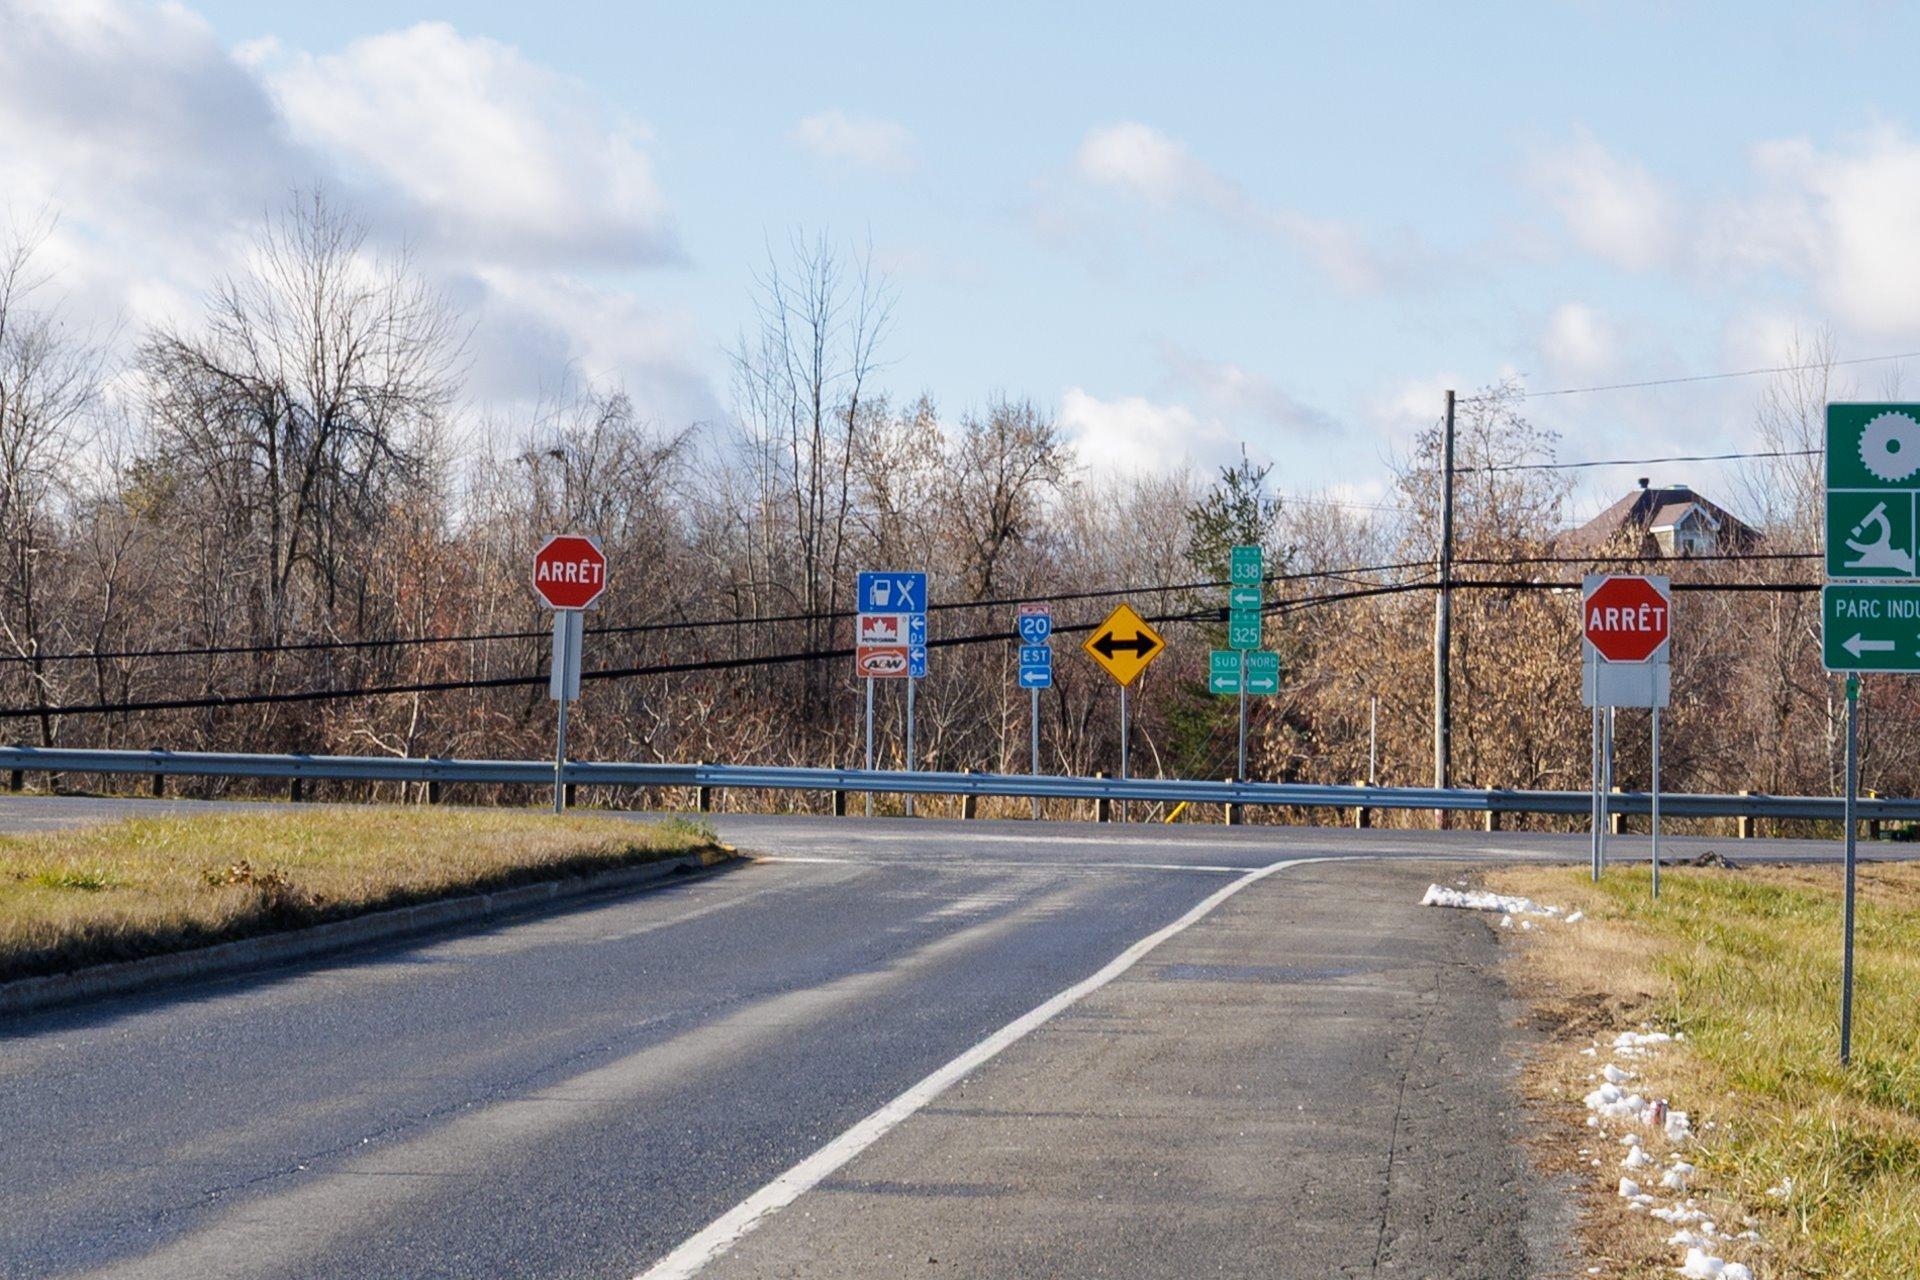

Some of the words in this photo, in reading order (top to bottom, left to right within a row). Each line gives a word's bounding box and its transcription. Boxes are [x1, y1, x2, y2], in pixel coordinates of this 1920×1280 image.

[537, 558, 602, 584] ARRÊT
[1234, 563, 1259, 579] 338
[1588, 602, 1665, 631] ARRÊT
[1835, 599, 1881, 618] PARC
[1024, 617, 1047, 634] 20
[1232, 627, 1257, 643] 325
[1023, 649, 1047, 662] EST
[1214, 656, 1238, 667] SUD
[1250, 656, 1277, 668] NORD
[868, 660, 902, 669] A&W
